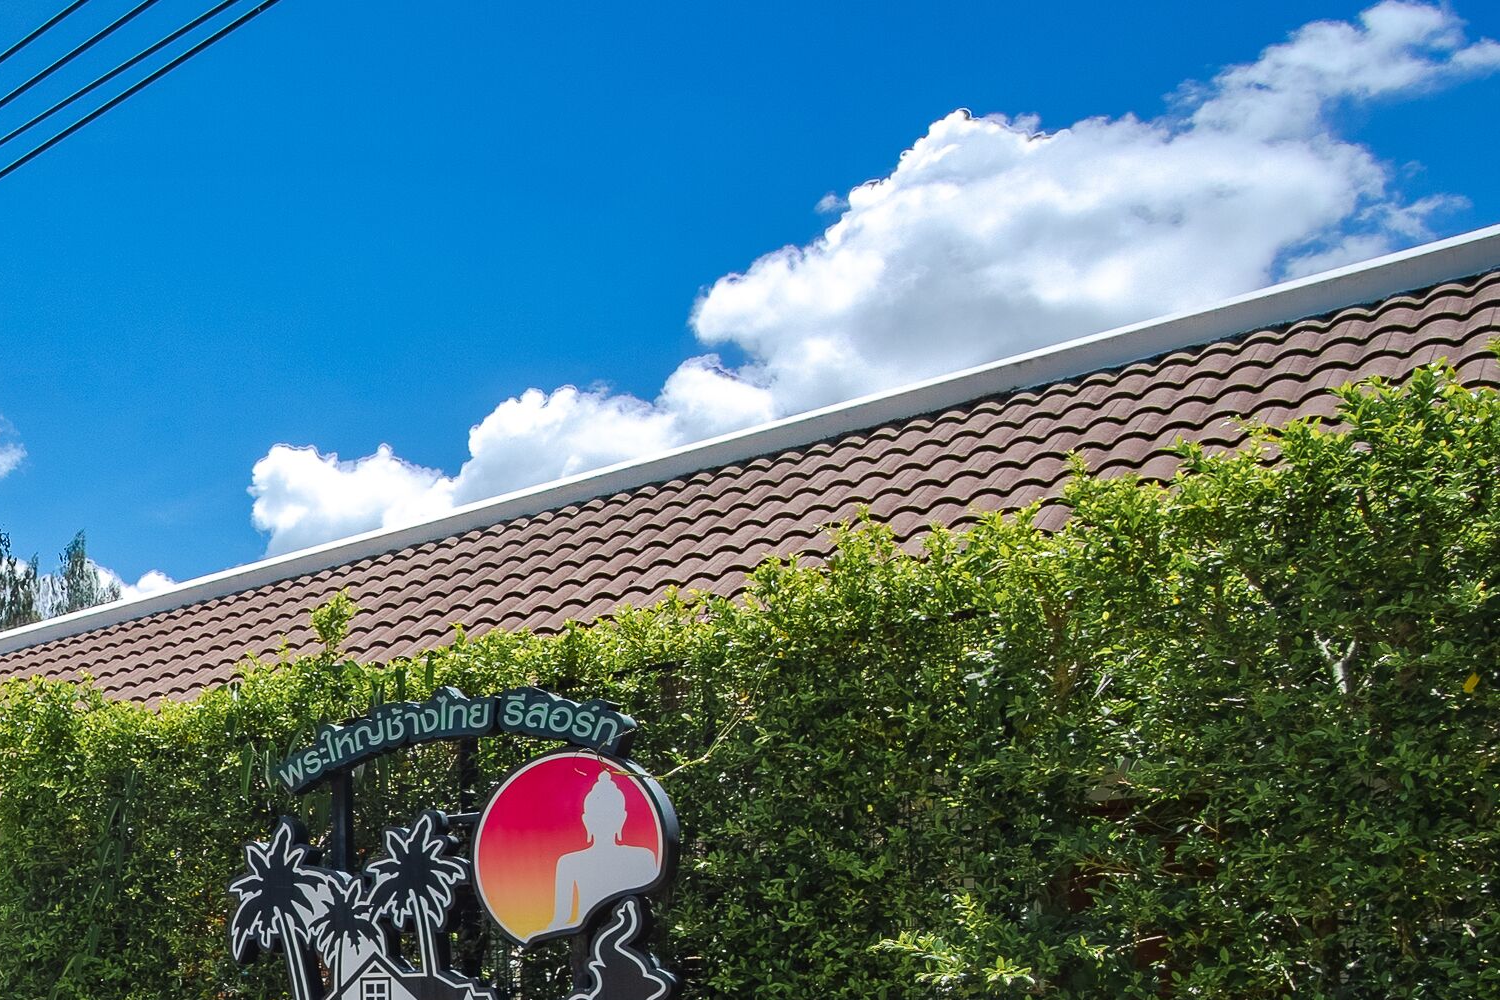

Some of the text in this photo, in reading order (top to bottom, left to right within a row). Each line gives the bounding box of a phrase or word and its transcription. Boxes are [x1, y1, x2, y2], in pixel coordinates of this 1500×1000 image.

[279, 693, 619, 788] พระใหญ่ช้างไทย รีสอร์ท
